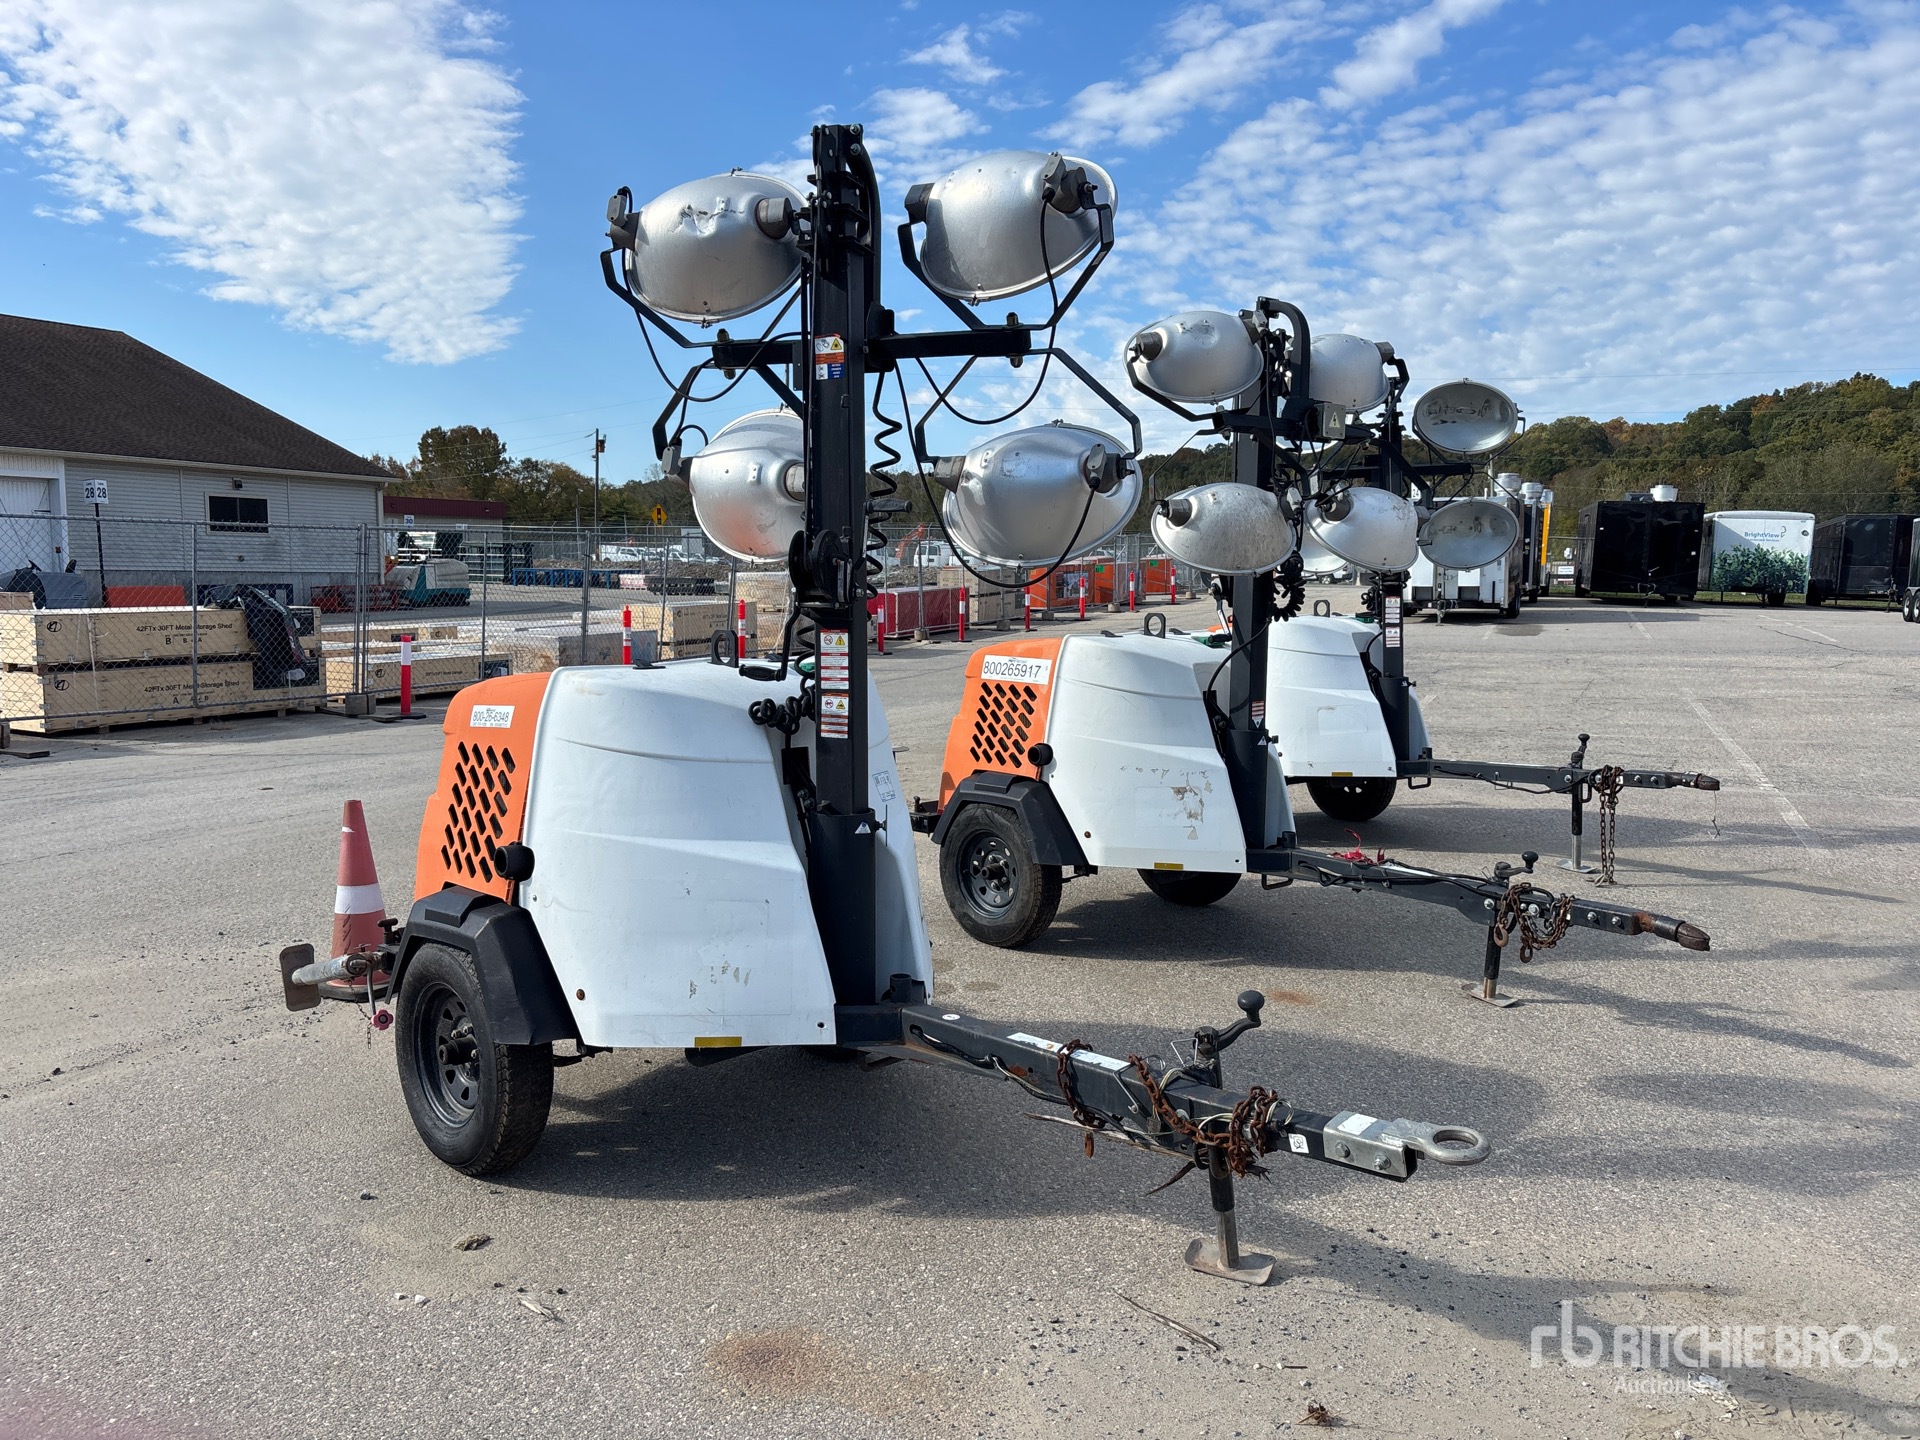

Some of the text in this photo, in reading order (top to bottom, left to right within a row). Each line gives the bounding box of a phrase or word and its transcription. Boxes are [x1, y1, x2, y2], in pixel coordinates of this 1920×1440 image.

[85, 487, 94, 498] 28
[96, 487, 106, 498] 28
[983, 661, 1042, 678] 800265917
[473, 711, 510, 722] 800-26-6348
